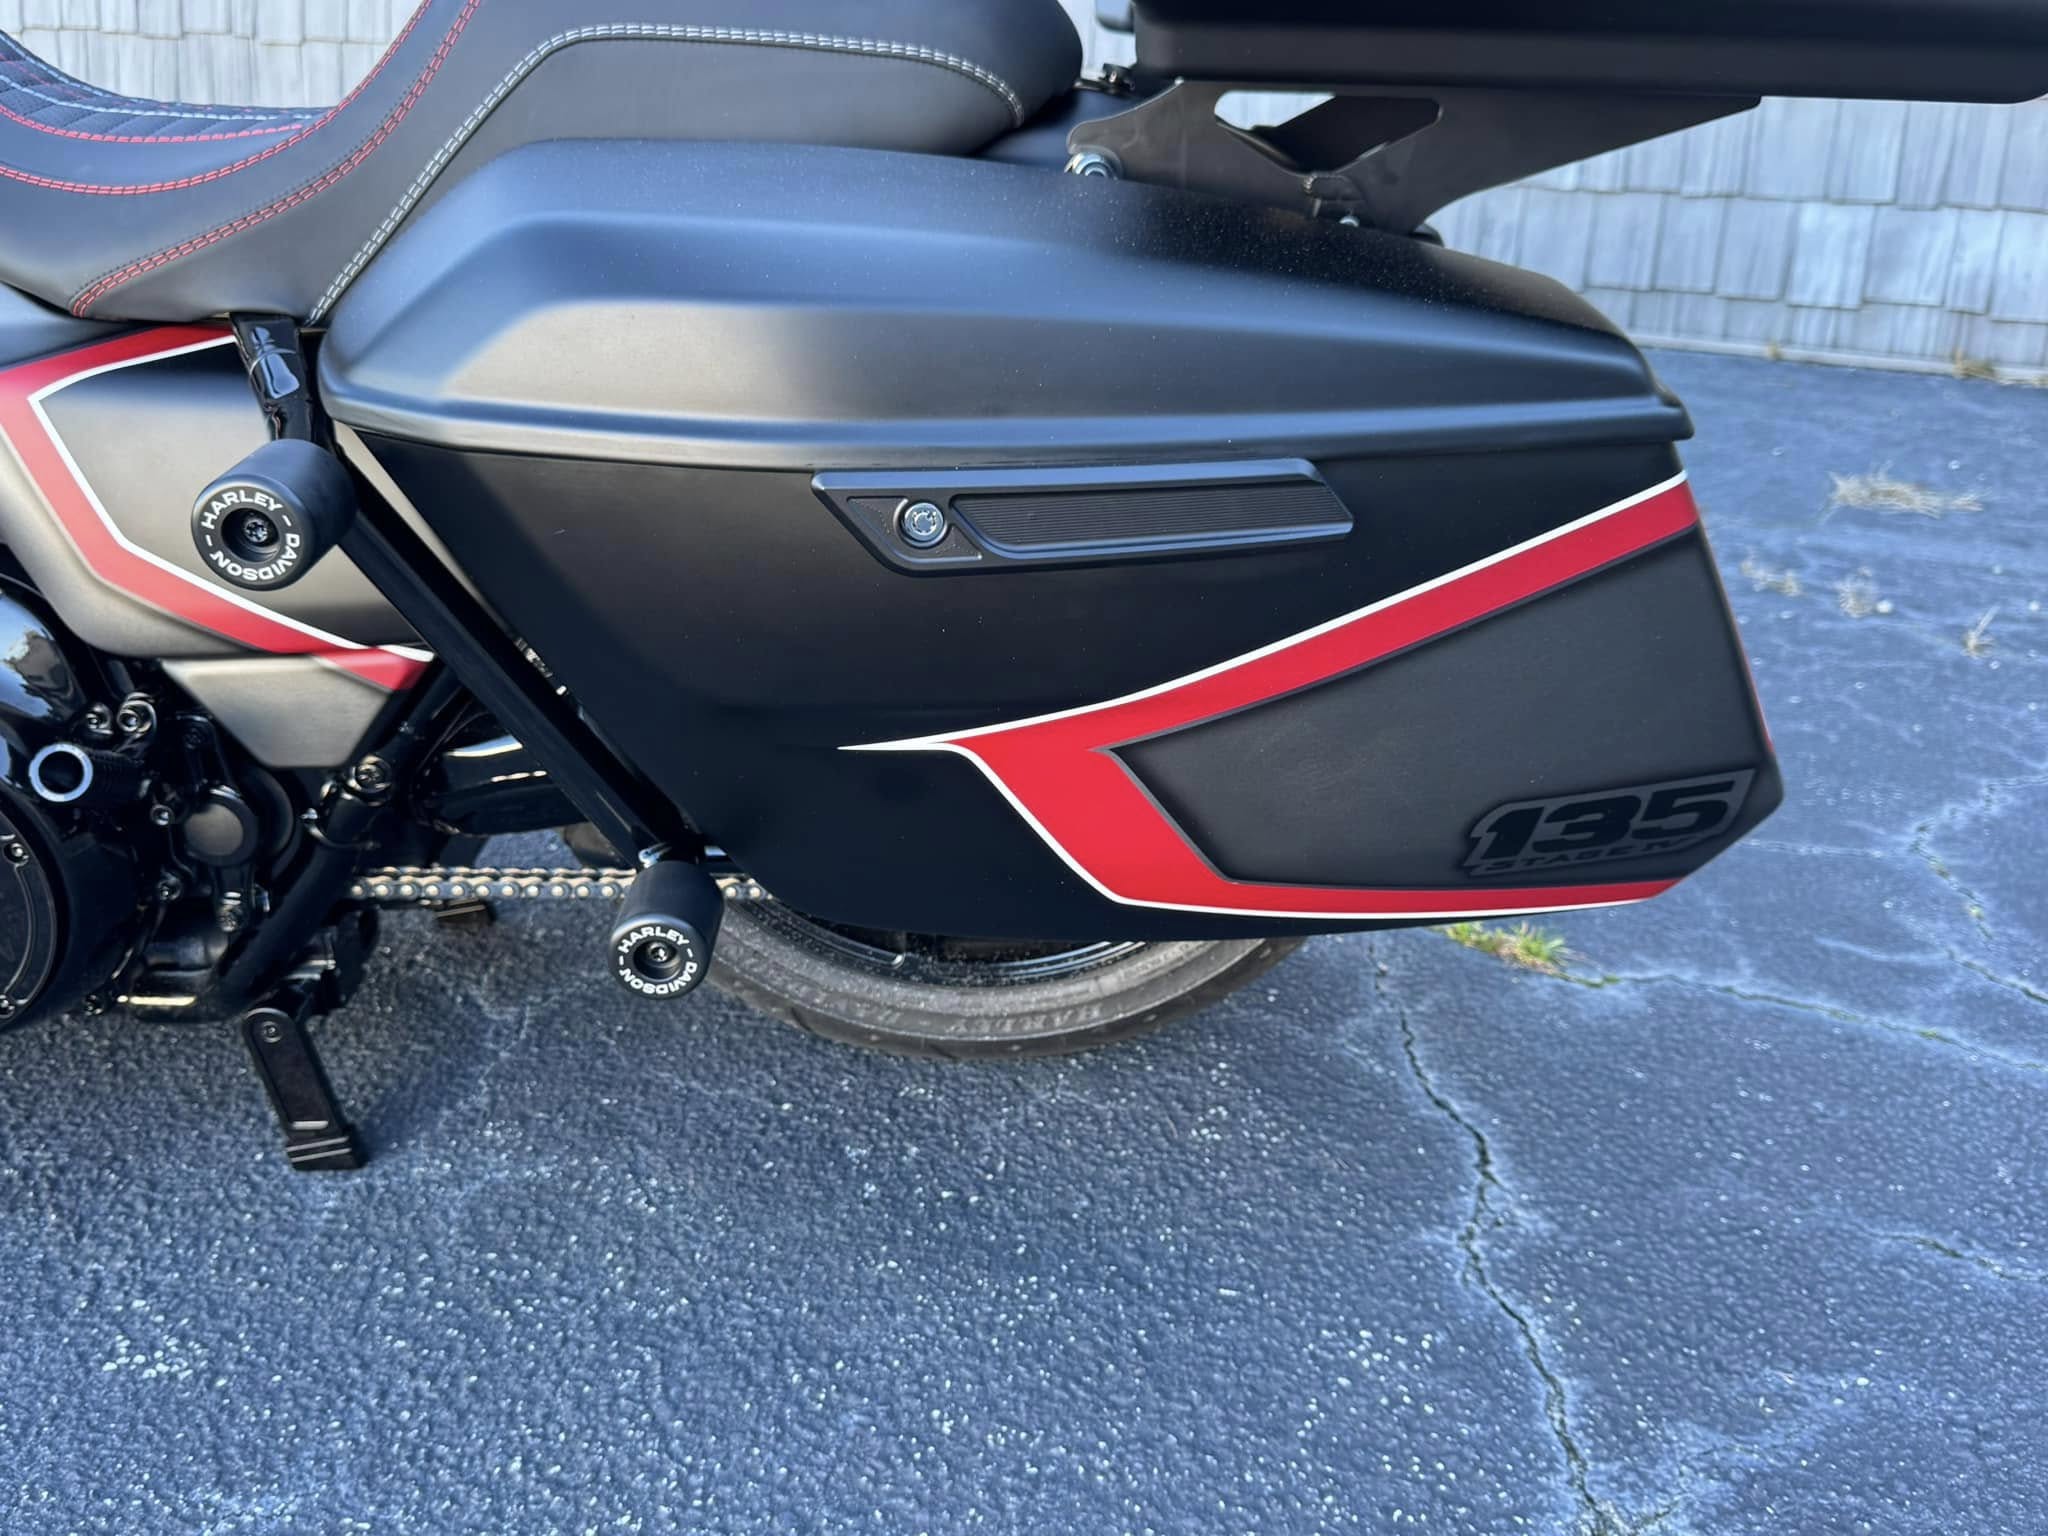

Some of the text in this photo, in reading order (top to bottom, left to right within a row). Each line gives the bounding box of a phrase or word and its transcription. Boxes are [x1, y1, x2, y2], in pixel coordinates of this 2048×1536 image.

[201, 490, 300, 581] HARLEY DAVIDSON
[1479, 780, 1737, 860] 135
[1482, 845, 1634, 871] STAGE
[617, 926, 698, 994] HARLEY DAVIDSON
